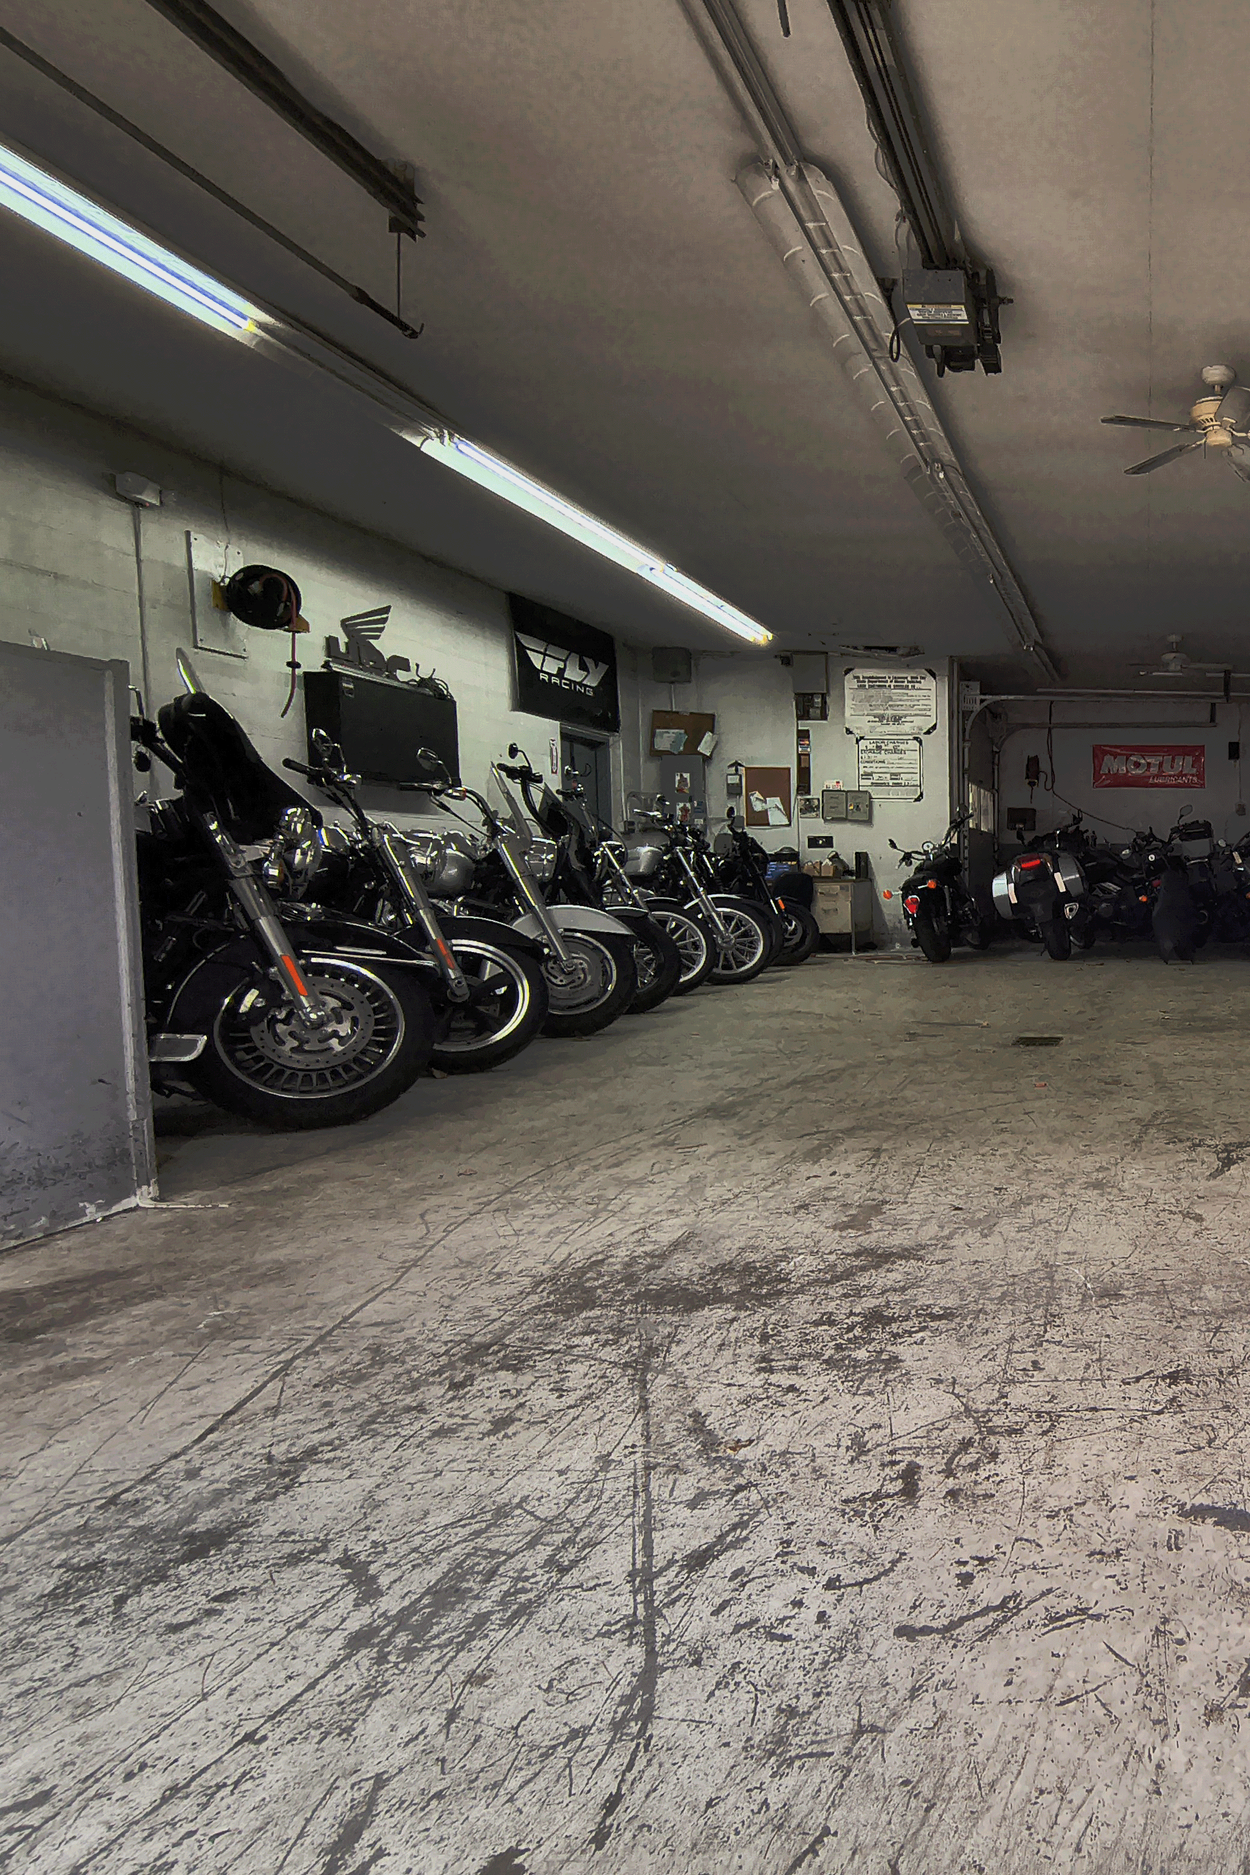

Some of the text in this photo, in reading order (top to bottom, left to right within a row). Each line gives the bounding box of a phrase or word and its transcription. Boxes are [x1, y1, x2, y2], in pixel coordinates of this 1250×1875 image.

[515, 631, 609, 687] FLY
[539, 673, 594, 697] RACING
[1100, 754, 1197, 775] MOTUL
